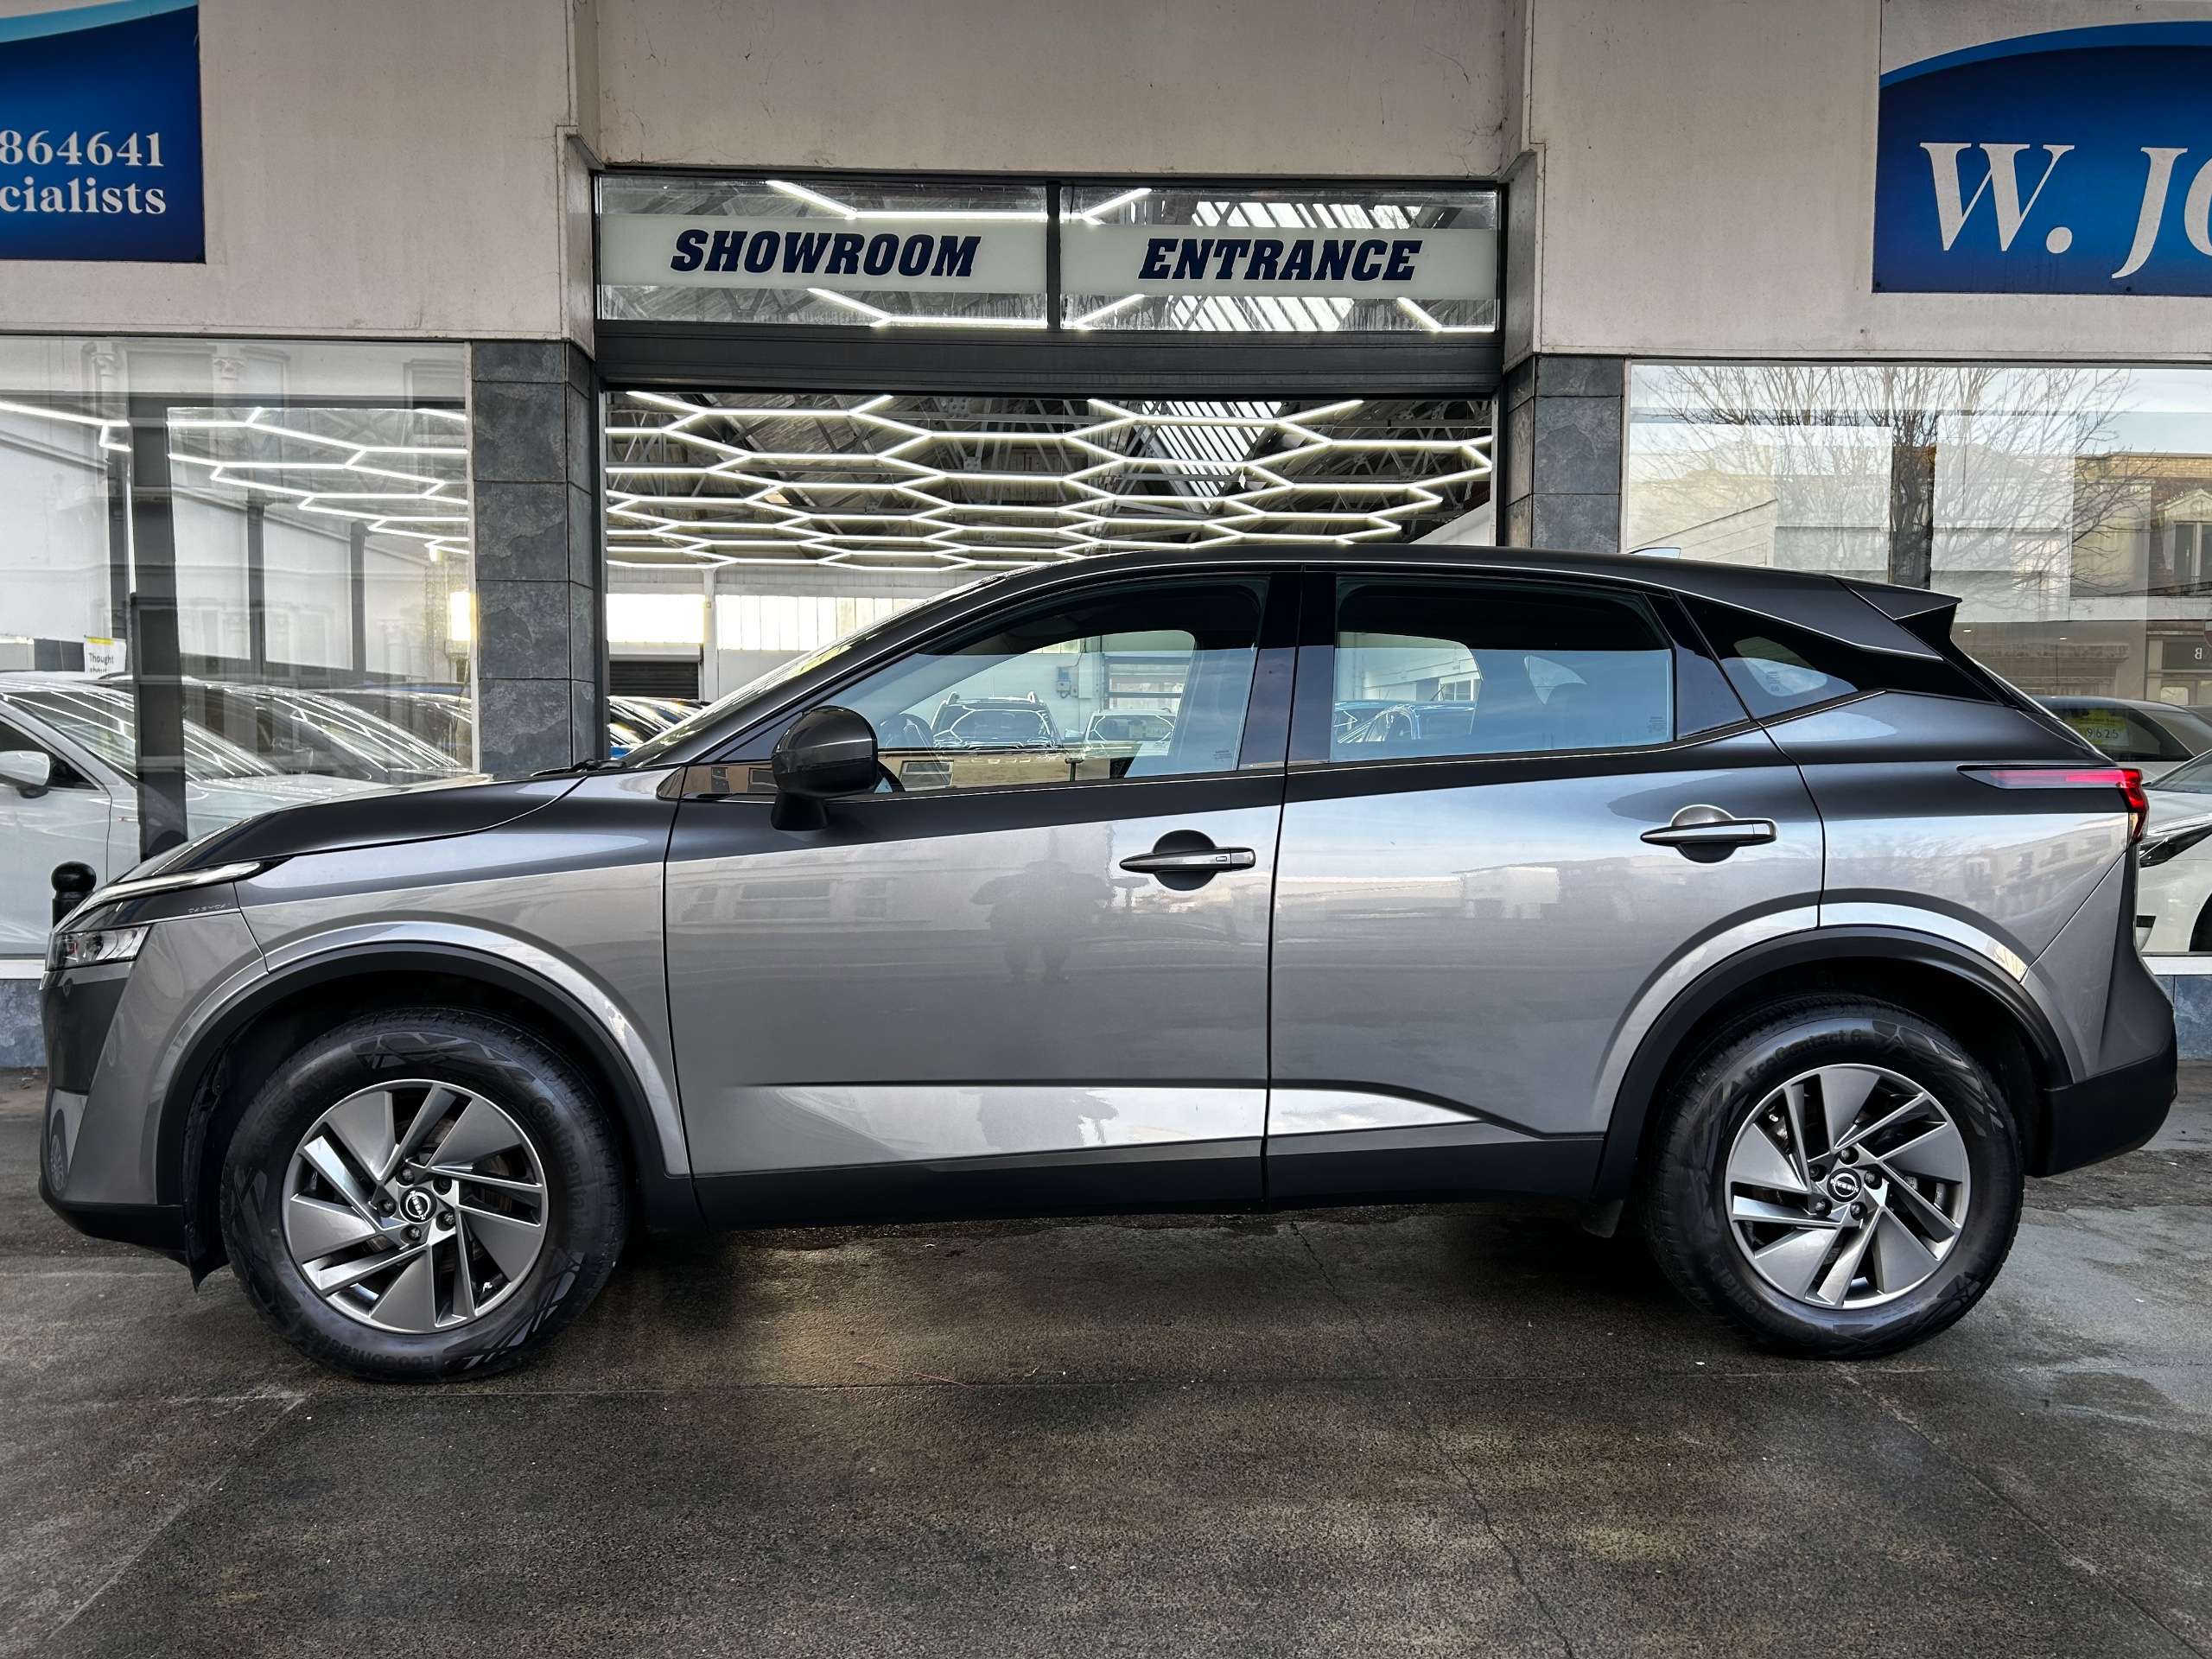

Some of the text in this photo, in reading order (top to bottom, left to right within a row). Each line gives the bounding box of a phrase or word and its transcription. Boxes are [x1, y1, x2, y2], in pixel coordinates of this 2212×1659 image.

[0, 130, 164, 167] 864641
[0, 175, 167, 214] cialists
[1919, 142, 2075, 254] W.
[670, 229, 982, 277] SHOWROOM
[1138, 238, 1423, 282] ENTRANCE
[88, 652, 114, 665] Thought
